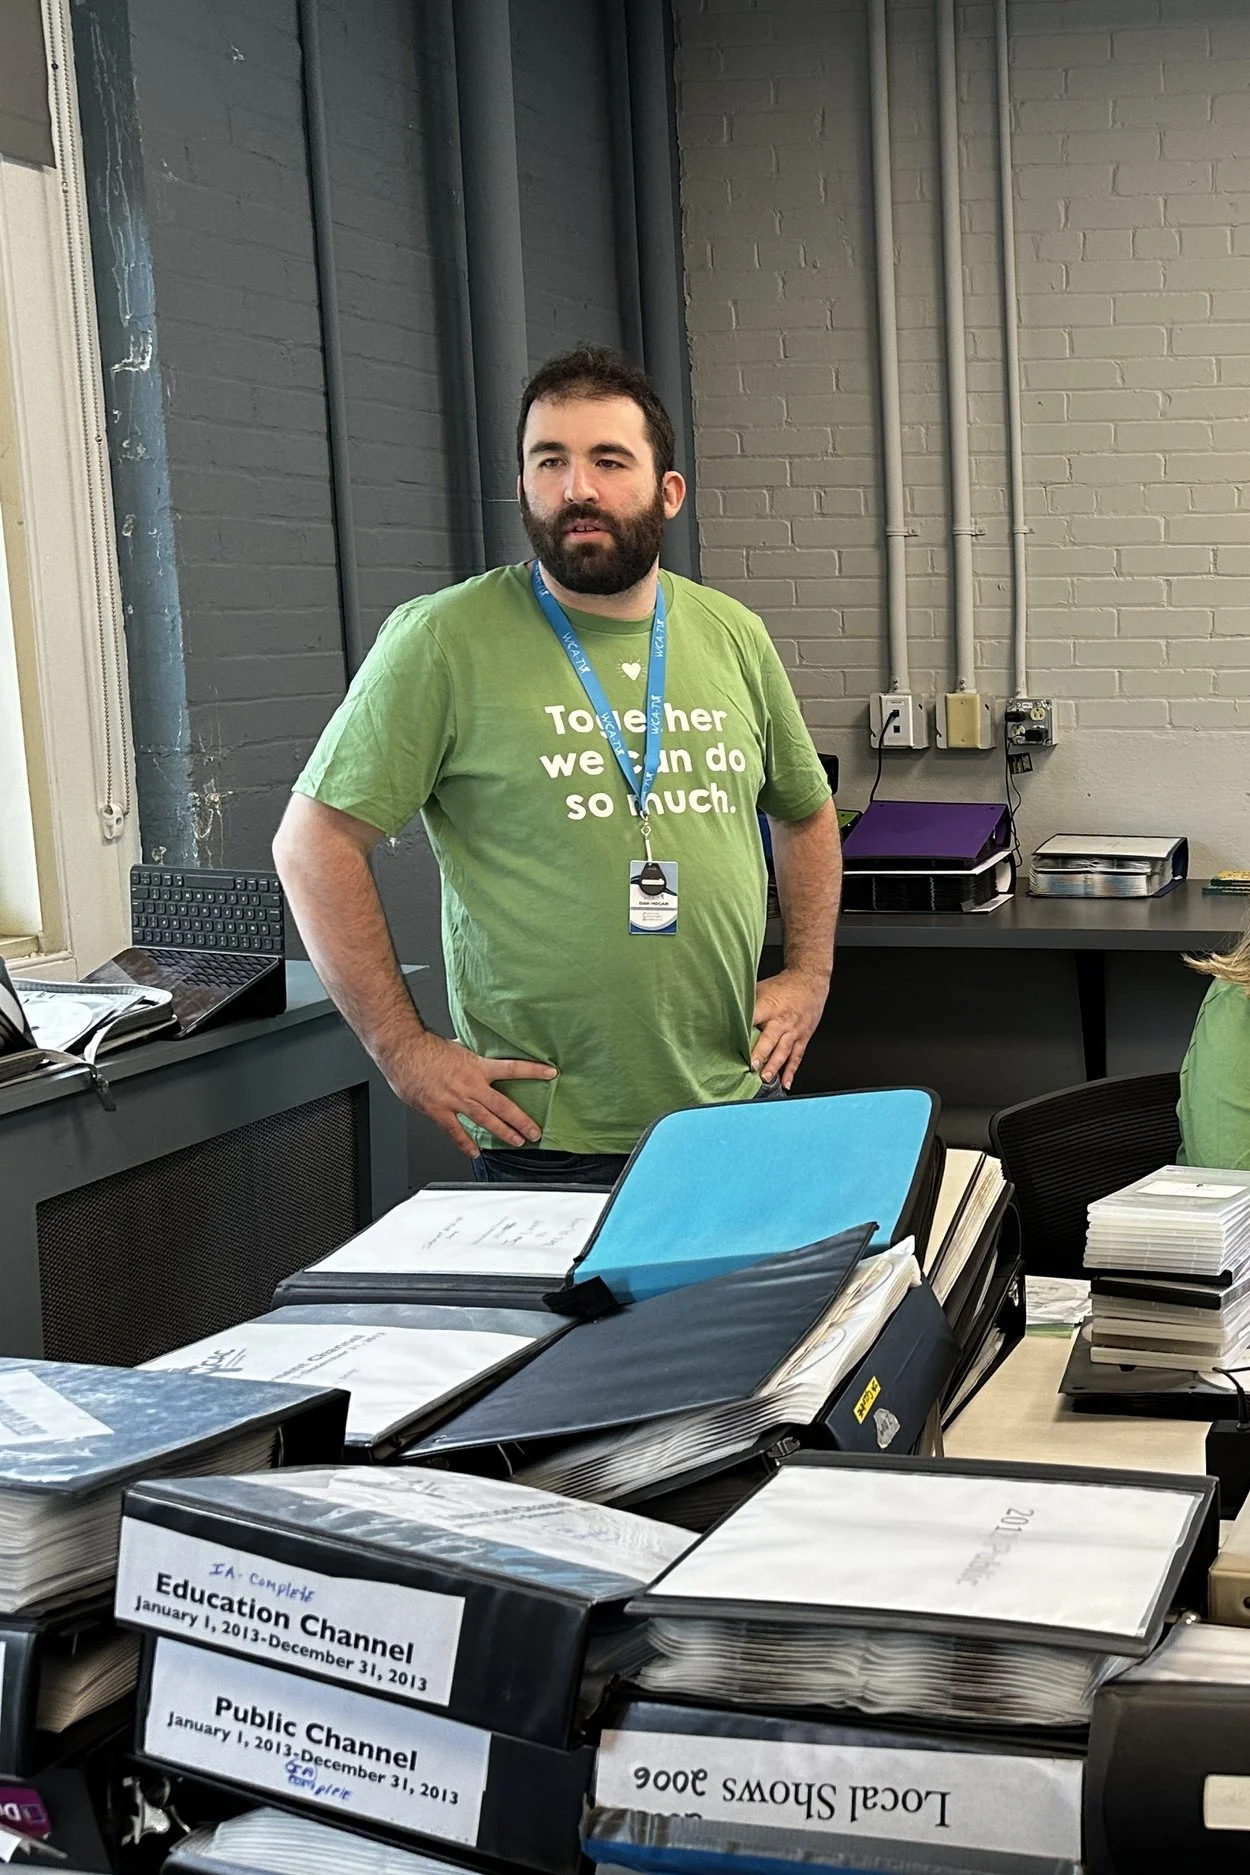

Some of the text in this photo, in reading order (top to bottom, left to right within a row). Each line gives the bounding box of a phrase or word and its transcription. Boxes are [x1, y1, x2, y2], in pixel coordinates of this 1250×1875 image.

[562, 631, 590, 675] WCA-TV
[654, 618, 665, 658] WCA-TV
[544, 702, 728, 739] Toeher
[601, 711, 625, 757] WCA-TV
[651, 694, 663, 736] WCA-TV
[539, 750, 605, 779] we
[705, 742, 747, 773] do
[566, 792, 615, 821] so
[155, 1571, 415, 1665] Education Channel
[134, 1595, 429, 1693] January 1, 2013-December 31, 2013
[214, 1695, 418, 1771] Public Channel
[167, 1710, 460, 1806] January 1, 2013-December 31, 2013
[632, 1765, 952, 1829] Local Shows 2006
